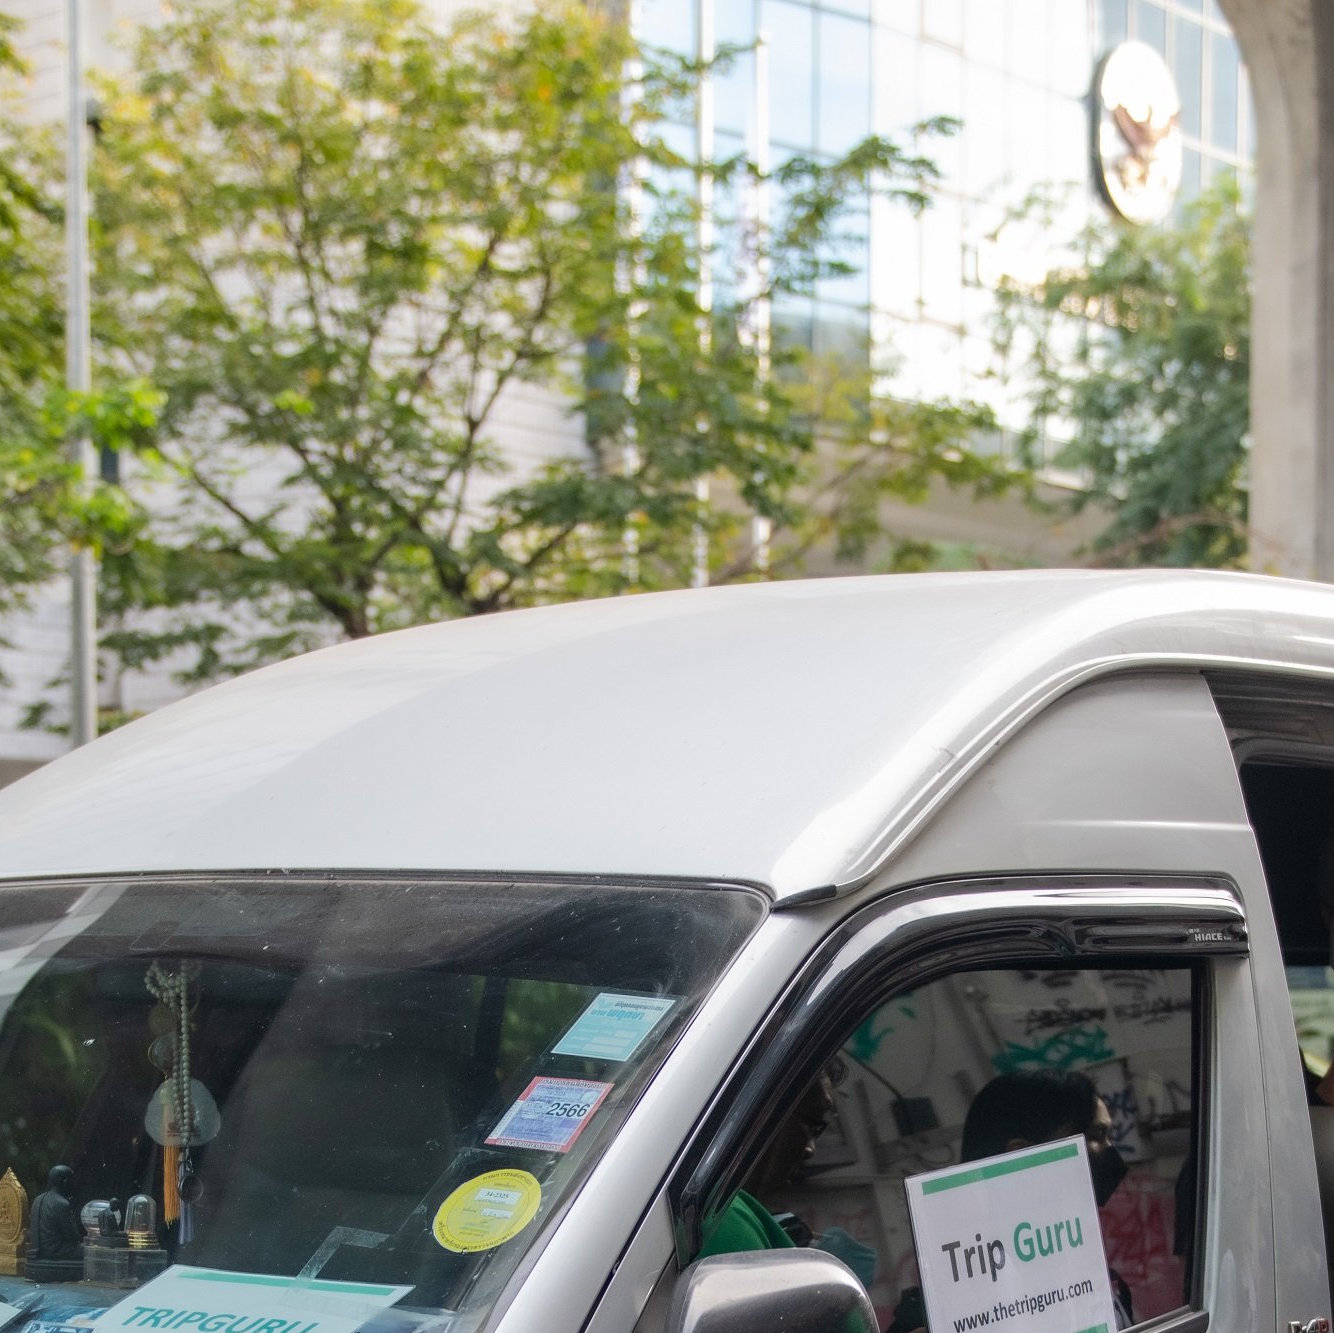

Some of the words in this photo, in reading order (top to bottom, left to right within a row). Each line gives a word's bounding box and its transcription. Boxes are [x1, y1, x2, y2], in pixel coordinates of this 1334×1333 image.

[1194, 933, 1223, 942] HIACE
[545, 1102, 590, 1117] 2566
[941, 1233, 1006, 1282] Trip
[1013, 1217, 1084, 1262] Guru
[953, 1279, 1093, 1333] www.thetripguru.com
